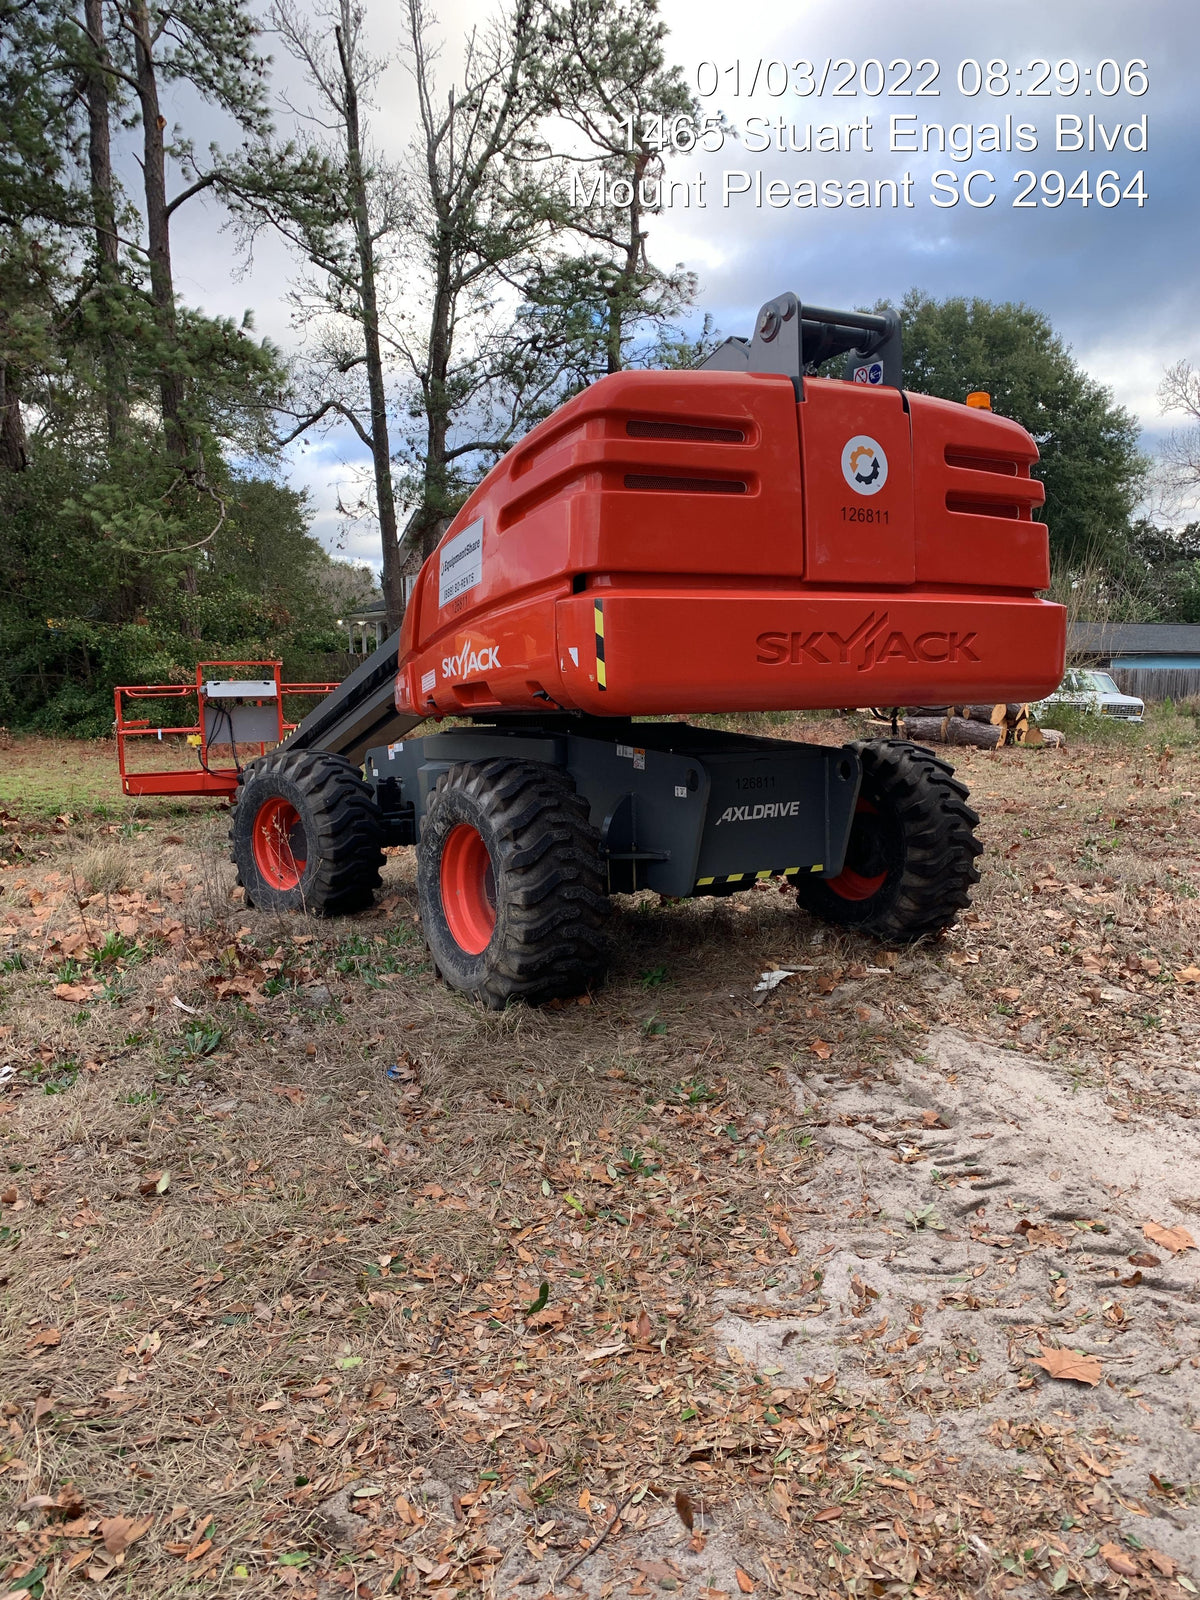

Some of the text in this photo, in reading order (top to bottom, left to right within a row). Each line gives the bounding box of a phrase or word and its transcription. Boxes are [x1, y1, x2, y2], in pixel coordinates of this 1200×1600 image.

[840, 506, 889, 525] 126811
[756, 611, 981, 672] SKYJACK
[441, 638, 502, 680] SKYJACK
[735, 776, 775, 790] 126811
[716, 801, 800, 826] AXLDRIVE
